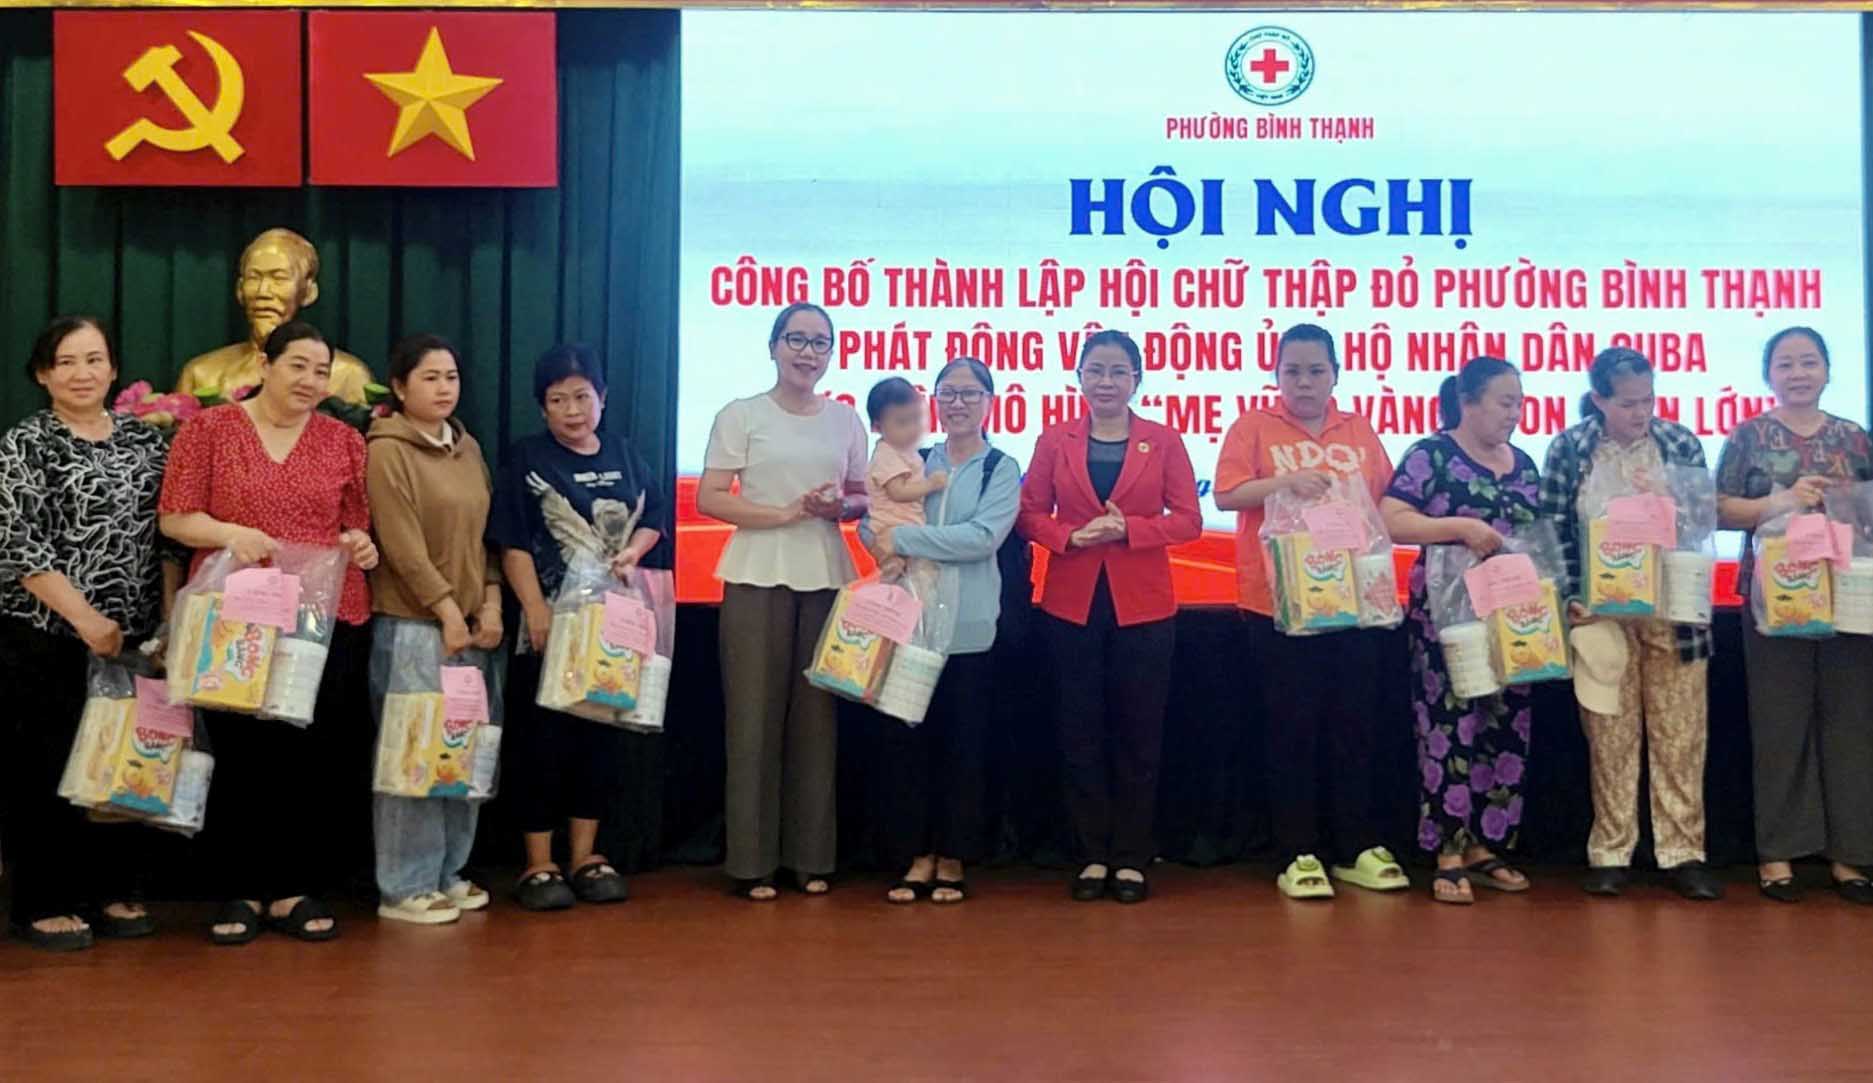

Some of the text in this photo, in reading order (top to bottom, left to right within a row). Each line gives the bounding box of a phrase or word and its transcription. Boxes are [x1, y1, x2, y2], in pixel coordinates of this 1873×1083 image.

[1166, 112, 1374, 144] PHƯỜNG BÌNH THẠNH
[1068, 165, 1473, 250] HỘI NGHỊ
[711, 256, 1821, 318] CÔNG BỐ THÀNH LẬP HỘI CHỮ THẬP ĐỎ PHƯỜNG BÌNH THẠNH
[839, 322, 932, 371] PHÁT
[1143, 323, 1242, 380] ĐỘNG
[1344, 323, 1392, 380] HỘ
[1408, 321, 1506, 371] NHÂN
[1523, 321, 1595, 372] DÂN
[1520, 396, 1566, 435] ON
